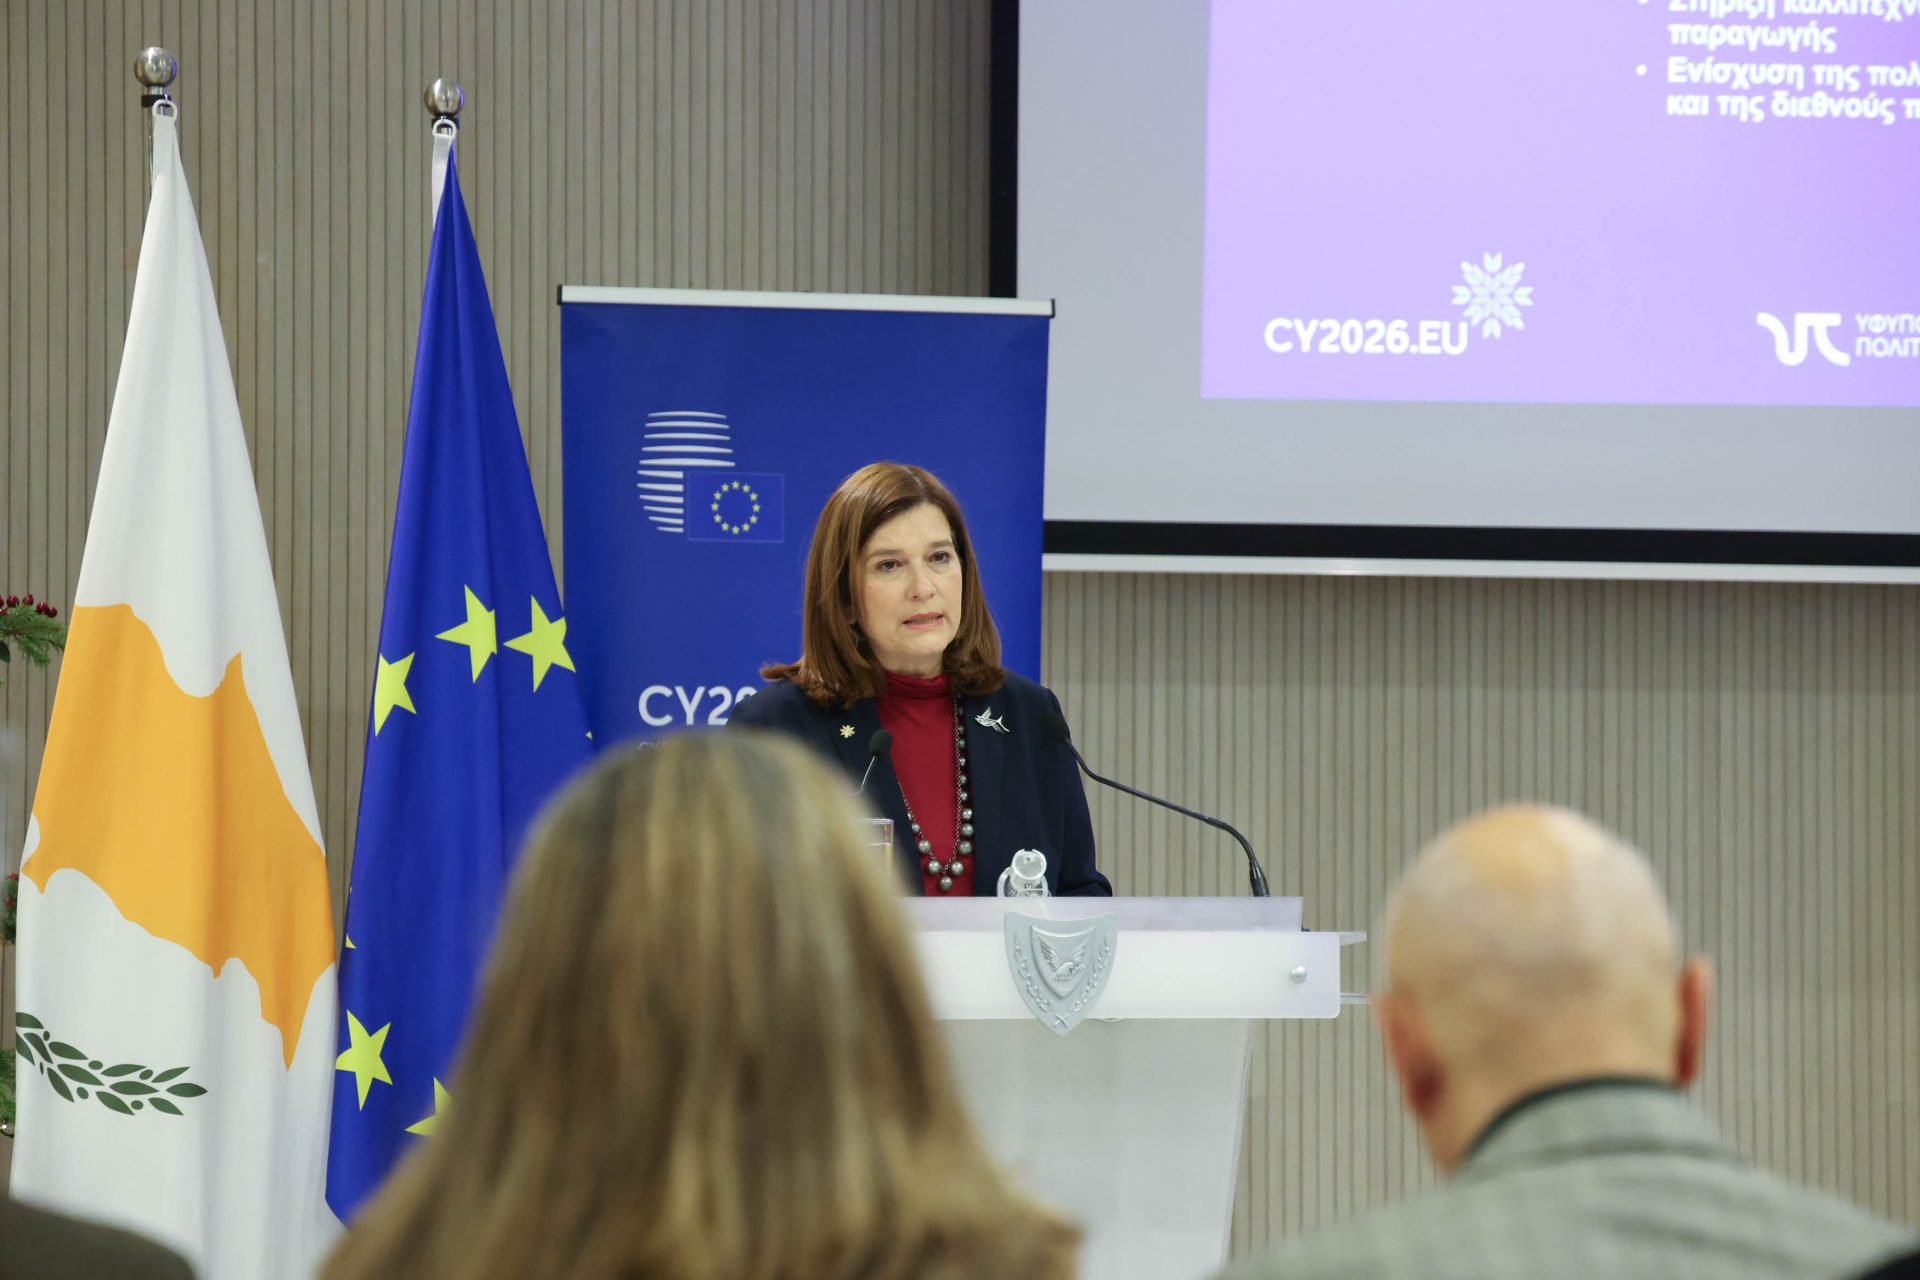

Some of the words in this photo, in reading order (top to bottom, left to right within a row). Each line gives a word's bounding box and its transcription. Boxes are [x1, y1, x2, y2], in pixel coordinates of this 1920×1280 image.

[1783, 0, 1920, 22] καλλιτεχν
[1667, 21, 1837, 54] παραγωγής
[1667, 56, 1805, 90] Ενίσχυση
[1811, 64, 1861, 92] της
[1666, 94, 1710, 116] και
[1715, 95, 1766, 123] της
[1770, 90, 1896, 125] διεθνούς
[1264, 317, 1469, 355] CY2026.EU
[1855, 313, 1920, 334] ΥΦΥΠ
